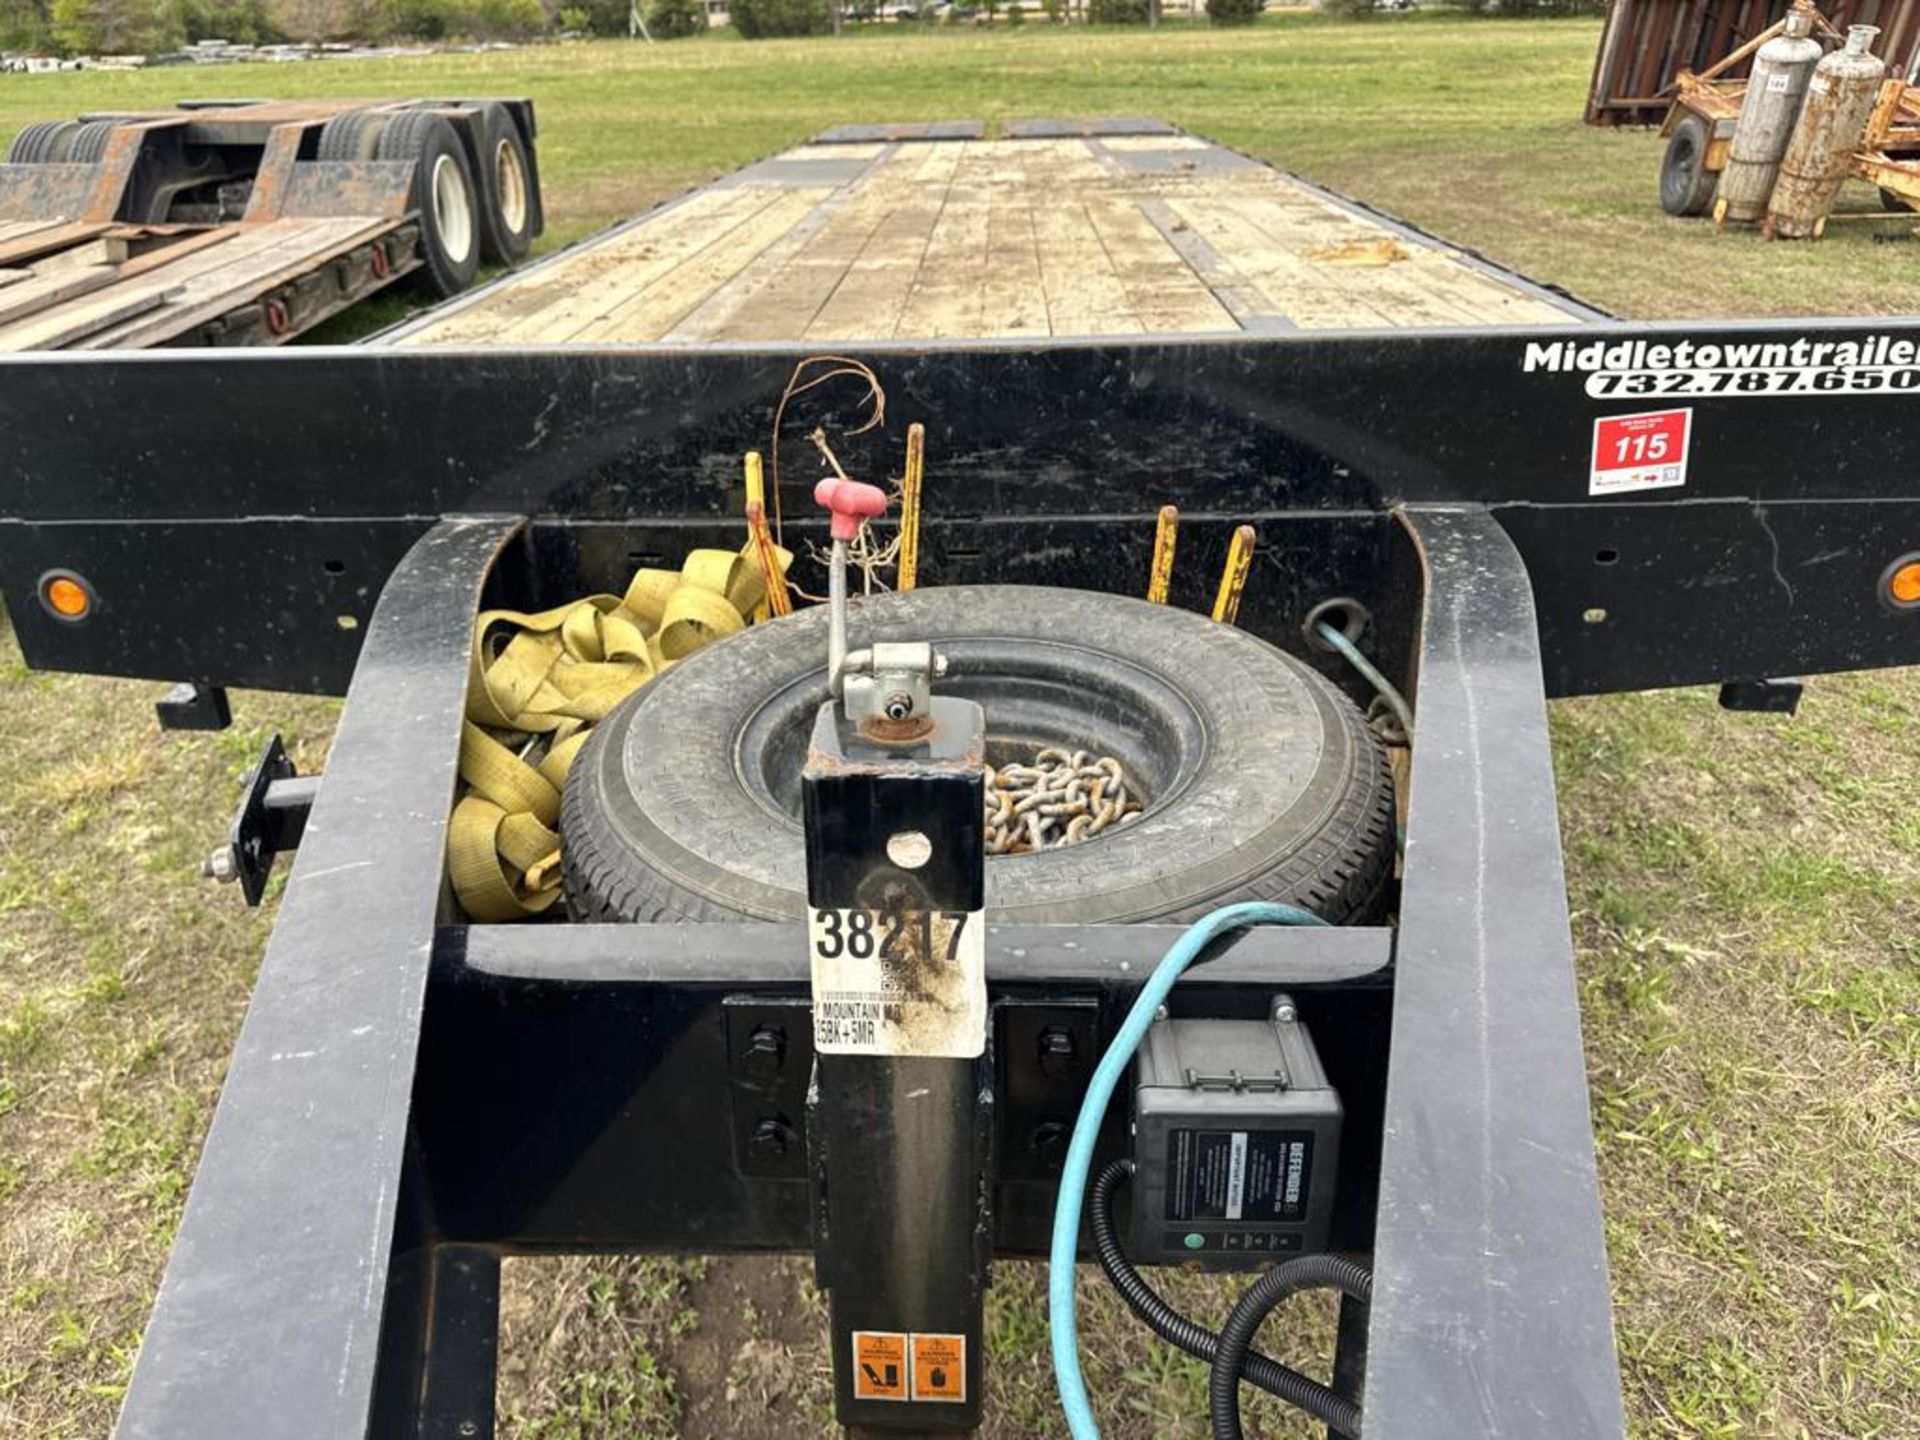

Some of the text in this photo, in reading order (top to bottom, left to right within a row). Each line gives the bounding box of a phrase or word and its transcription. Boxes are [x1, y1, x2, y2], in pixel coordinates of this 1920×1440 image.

[1523, 335, 1920, 372] Middletowntraile
[1597, 368, 1920, 395] 732.787.650
[1616, 433, 1669, 462] 115
[816, 909, 968, 961] 38217
[823, 1002, 880, 1020] MOUNTAIN
